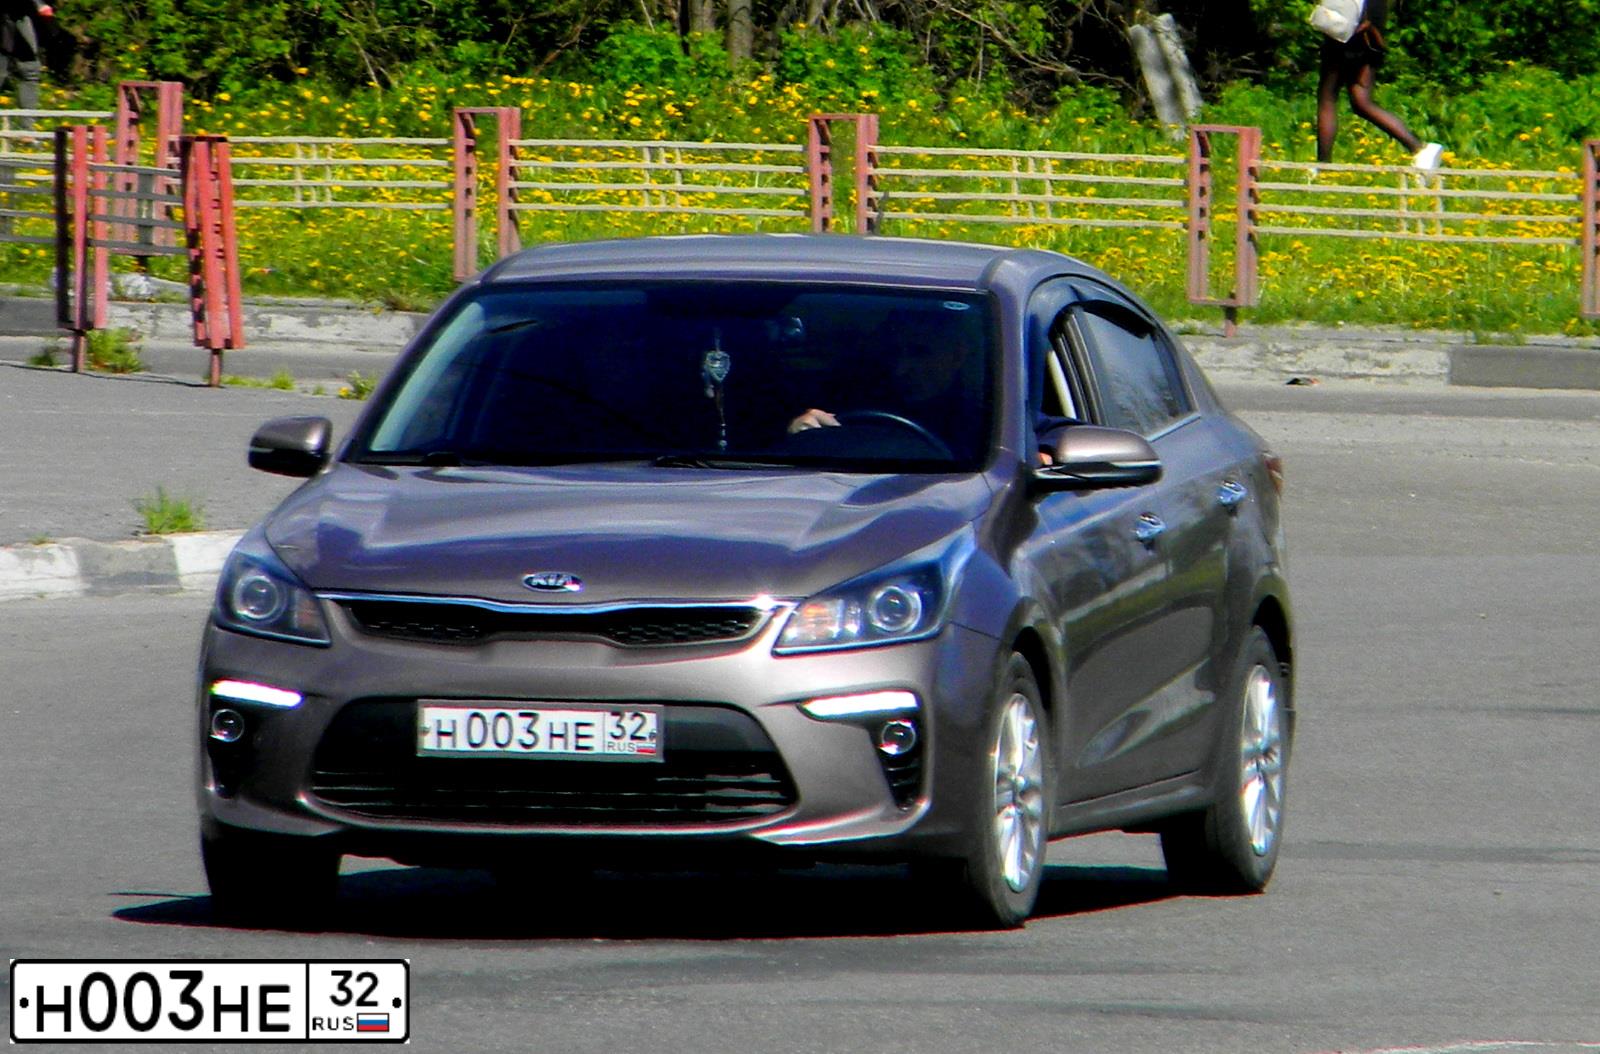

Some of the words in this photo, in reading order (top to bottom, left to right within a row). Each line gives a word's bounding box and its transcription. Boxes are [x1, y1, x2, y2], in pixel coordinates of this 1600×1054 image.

[436, 711, 595, 751] H003HE
[609, 711, 648, 741] 32
[607, 741, 636, 753] RUS
